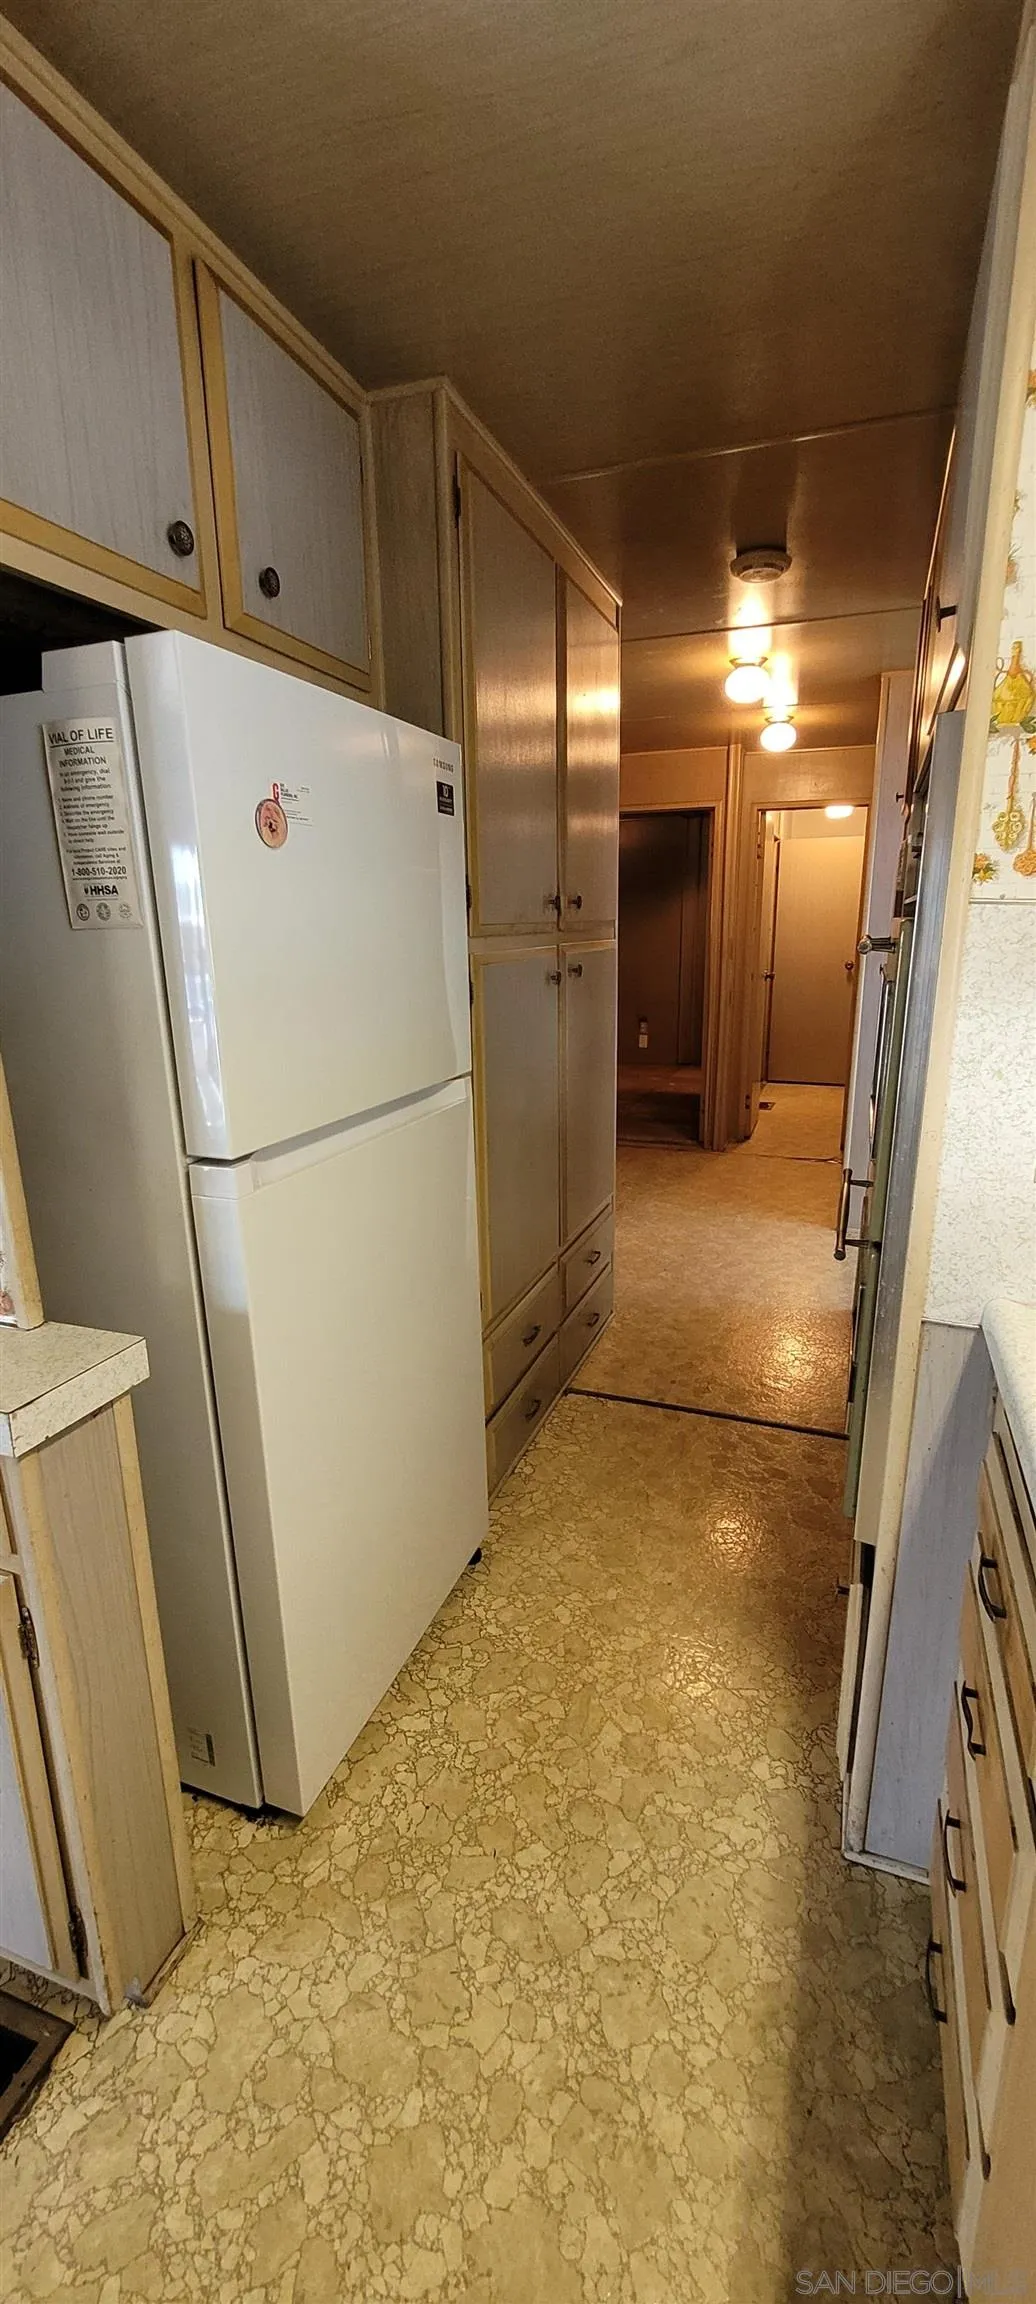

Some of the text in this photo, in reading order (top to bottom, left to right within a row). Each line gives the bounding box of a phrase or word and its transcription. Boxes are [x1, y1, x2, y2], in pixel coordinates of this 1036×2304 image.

[48, 728, 113, 744] VIAL OF LIFE
[64, 746, 95, 755] MEDICAL
[59, 757, 106, 768] INFORMATION
[71, 866, 127, 876] 1-800-510-2020
[90, 885, 119, 896] HHSA
